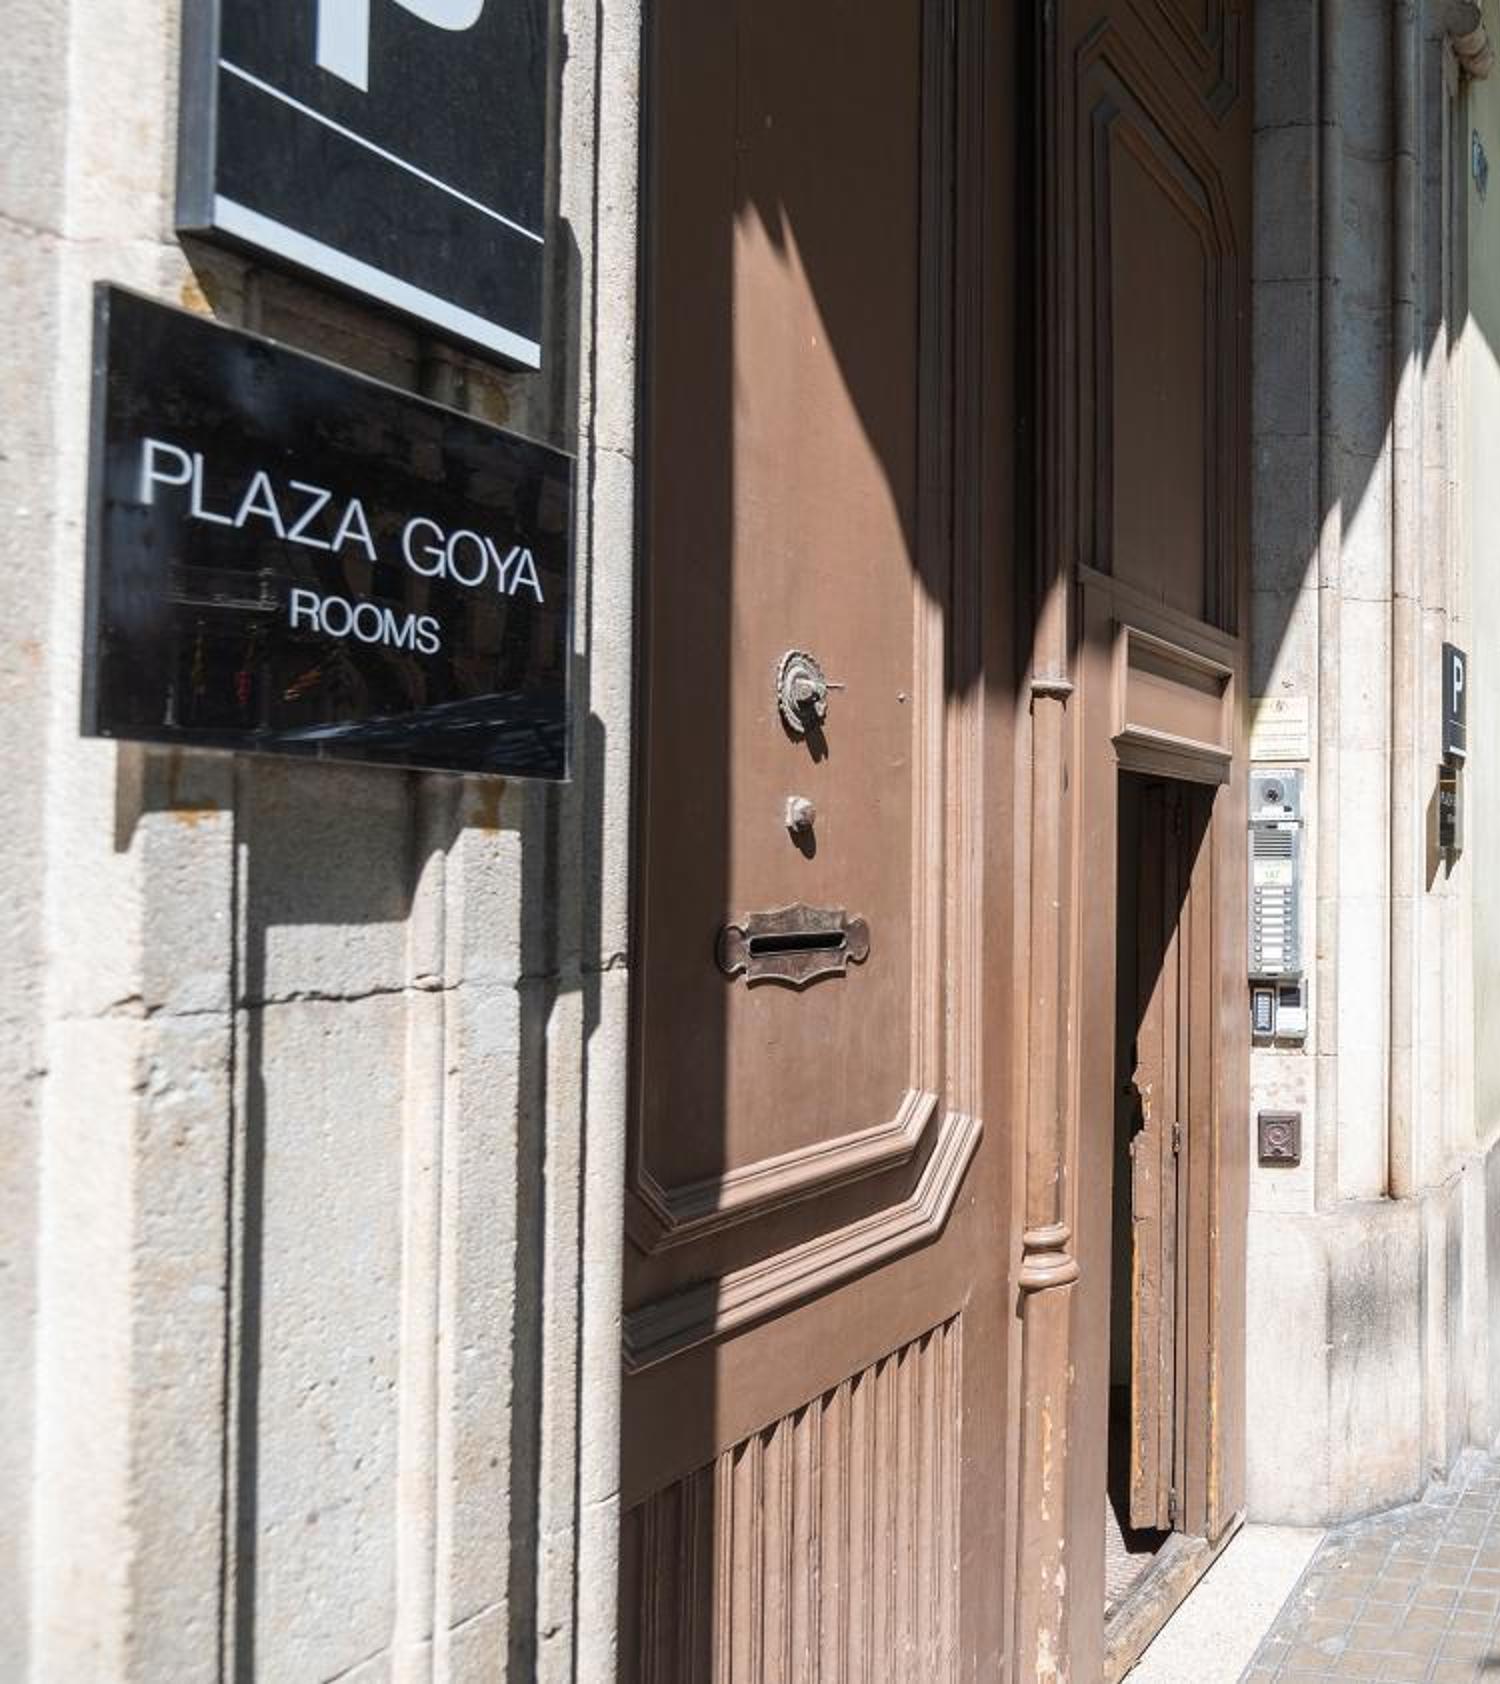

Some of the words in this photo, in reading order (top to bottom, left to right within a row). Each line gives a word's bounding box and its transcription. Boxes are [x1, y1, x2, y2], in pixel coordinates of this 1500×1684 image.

[138, 437, 378, 562] PLAZA
[401, 517, 544, 603] GOYA
[289, 588, 442, 655] ROOMS
[1453, 655, 1464, 714] P
